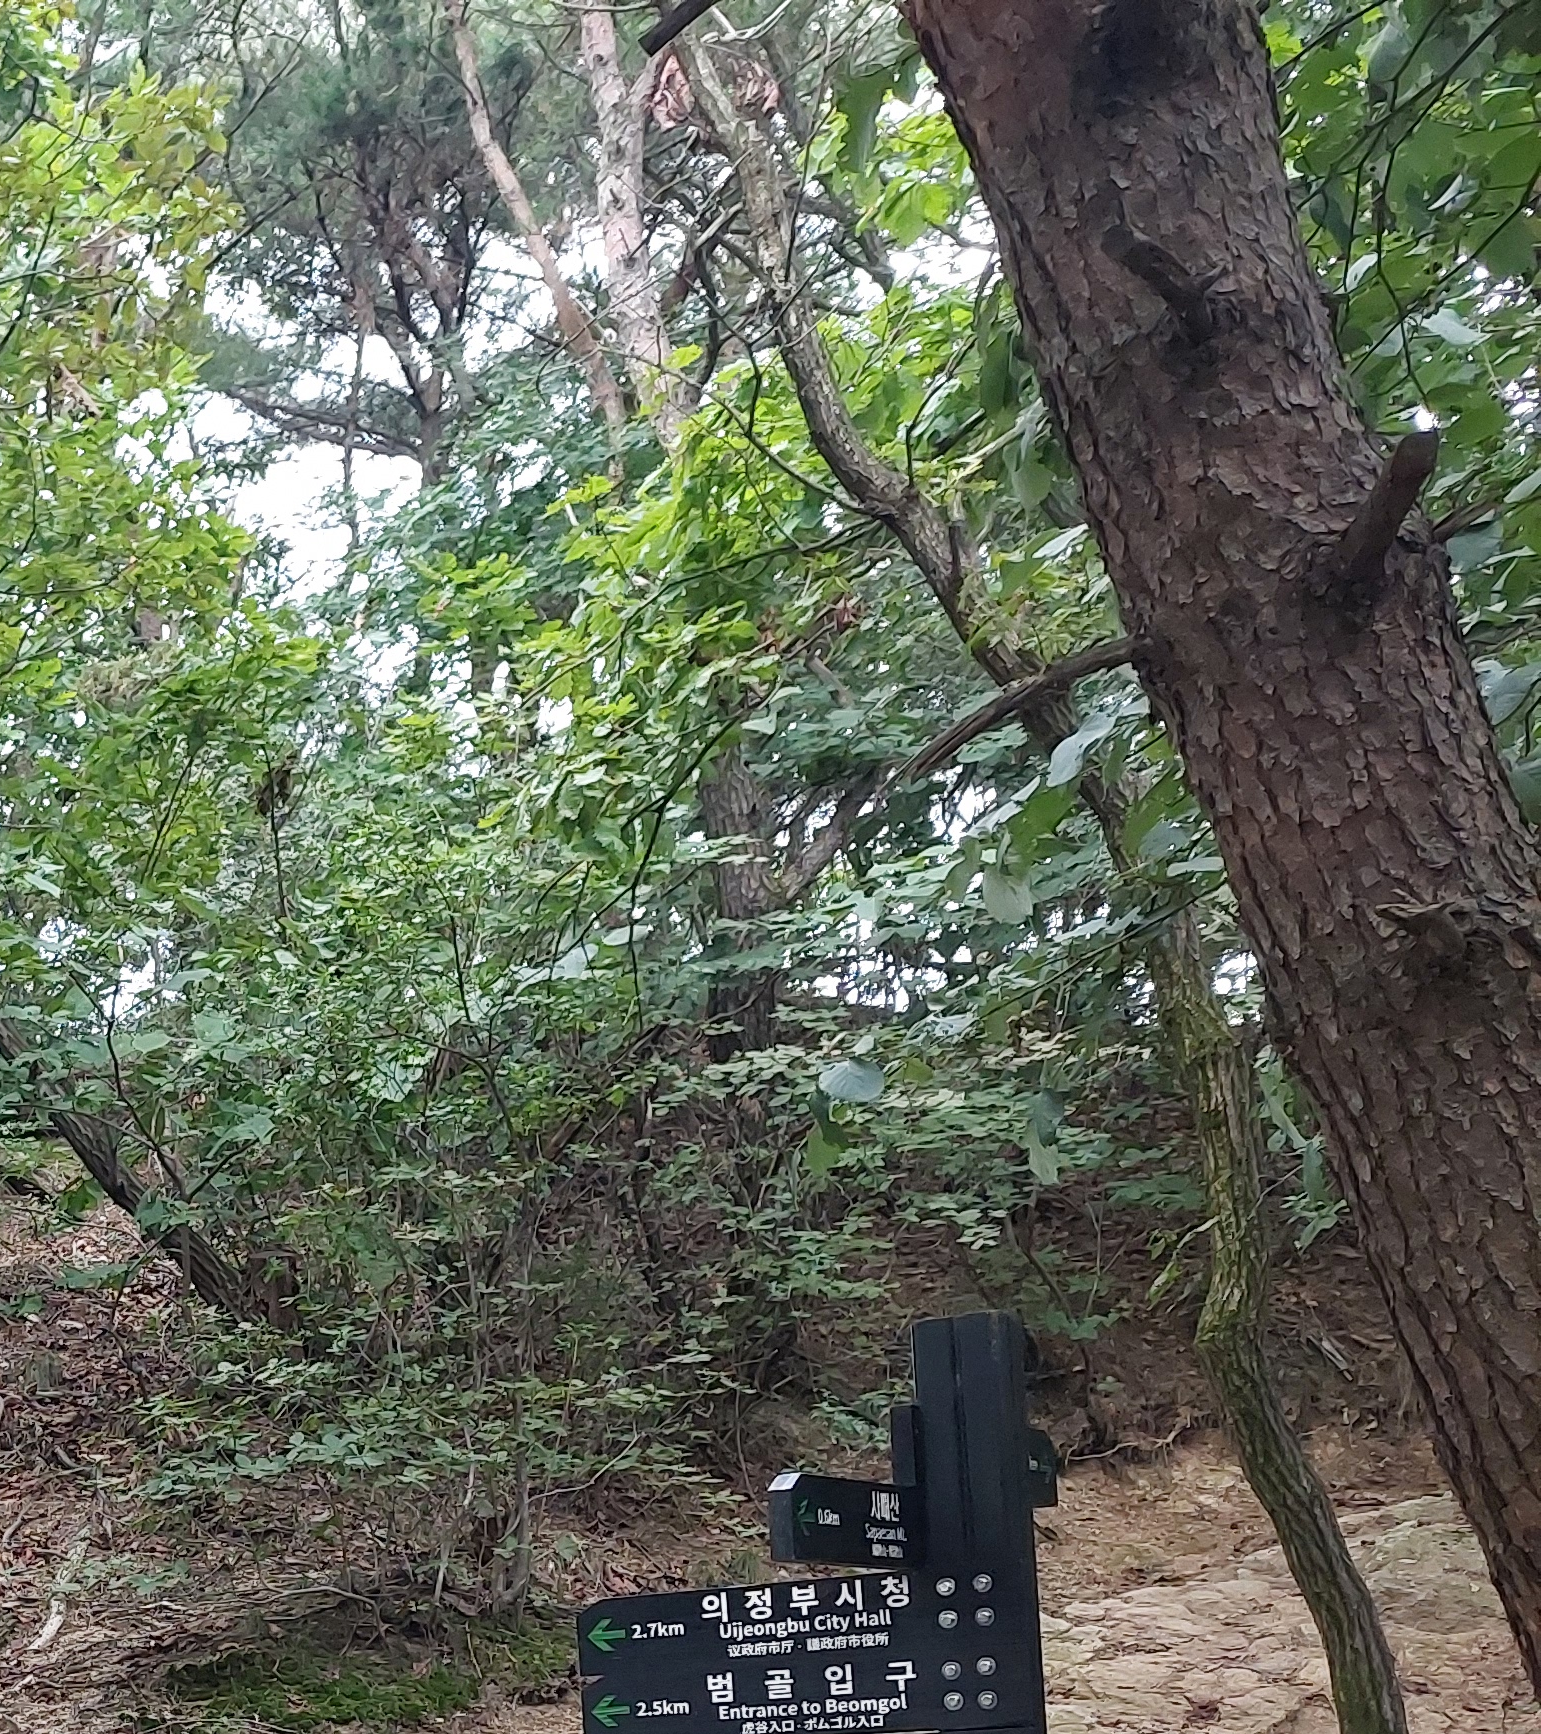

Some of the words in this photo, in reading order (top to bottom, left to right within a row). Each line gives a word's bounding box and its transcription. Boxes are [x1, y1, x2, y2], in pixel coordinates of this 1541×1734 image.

[631, 1622, 685, 1639] 2.7km
[720, 1619, 810, 1641] Uijeongbu
[814, 1613, 850, 1633] City
[854, 1608, 892, 1627] Hall
[636, 1700, 690, 1717] 2.5km
[719, 1703, 798, 1720] Entrance
[801, 1701, 821, 1715] to
[825, 1693, 908, 1715] Beomgol
